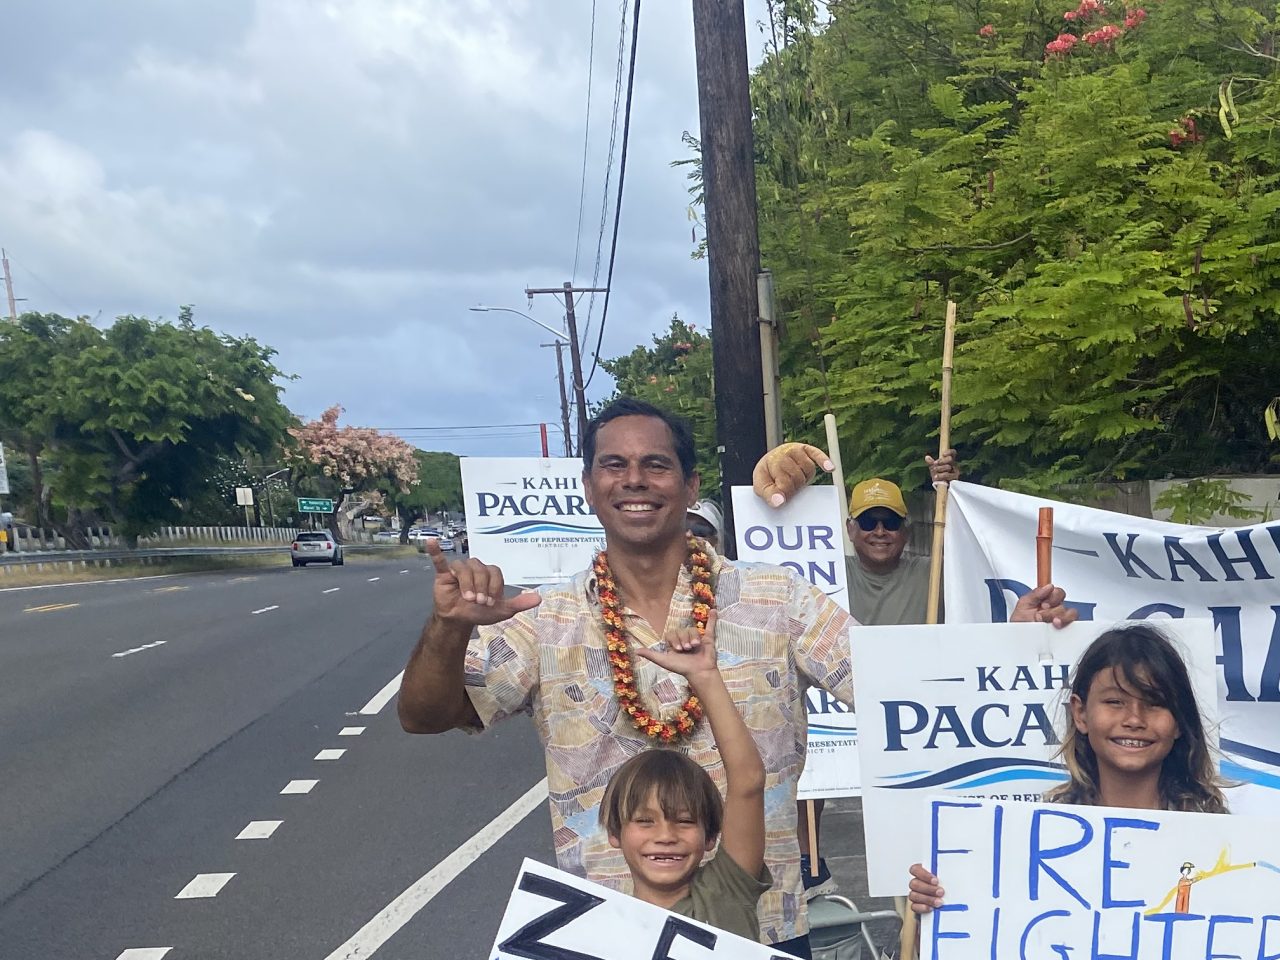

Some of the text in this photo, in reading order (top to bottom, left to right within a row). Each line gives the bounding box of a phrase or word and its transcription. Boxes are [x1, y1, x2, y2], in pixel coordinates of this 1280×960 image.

[522, 477, 578, 489] KAHI
[476, 492, 597, 516] PACAR
[744, 525, 836, 551] OUR
[930, 801, 1160, 910] FIRE
